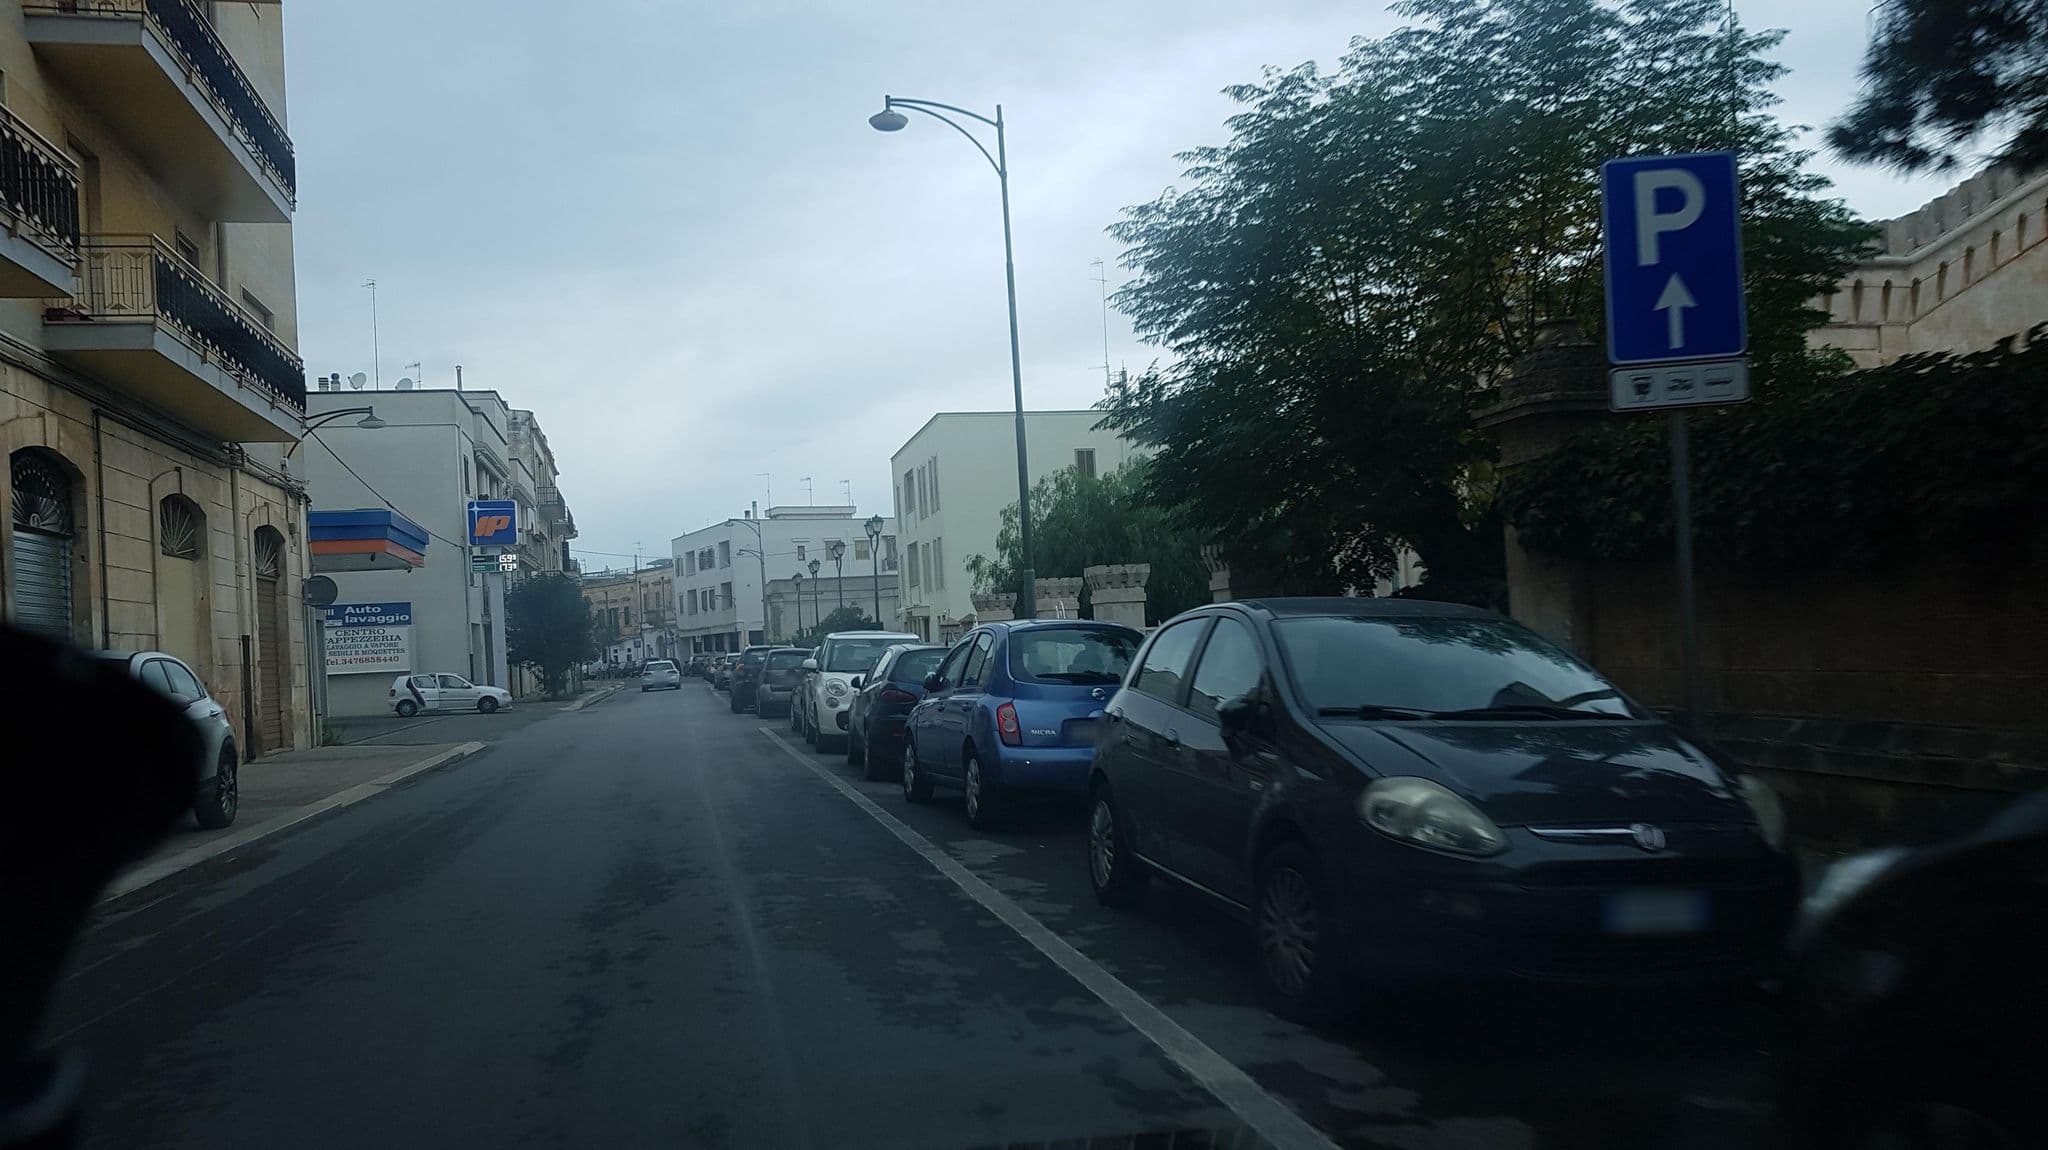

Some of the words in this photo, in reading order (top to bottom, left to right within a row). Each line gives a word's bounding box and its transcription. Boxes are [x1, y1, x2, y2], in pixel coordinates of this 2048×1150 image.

[1633, 168, 1707, 267] P
[474, 515, 512, 537] IP
[345, 605, 382, 614] Auto
[345, 613, 410, 624] lavaggio
[335, 628, 386, 637] CENTRO
[325, 635, 402, 645] APPEZZERIA
[361, 648, 406, 656] MOQUETTES
